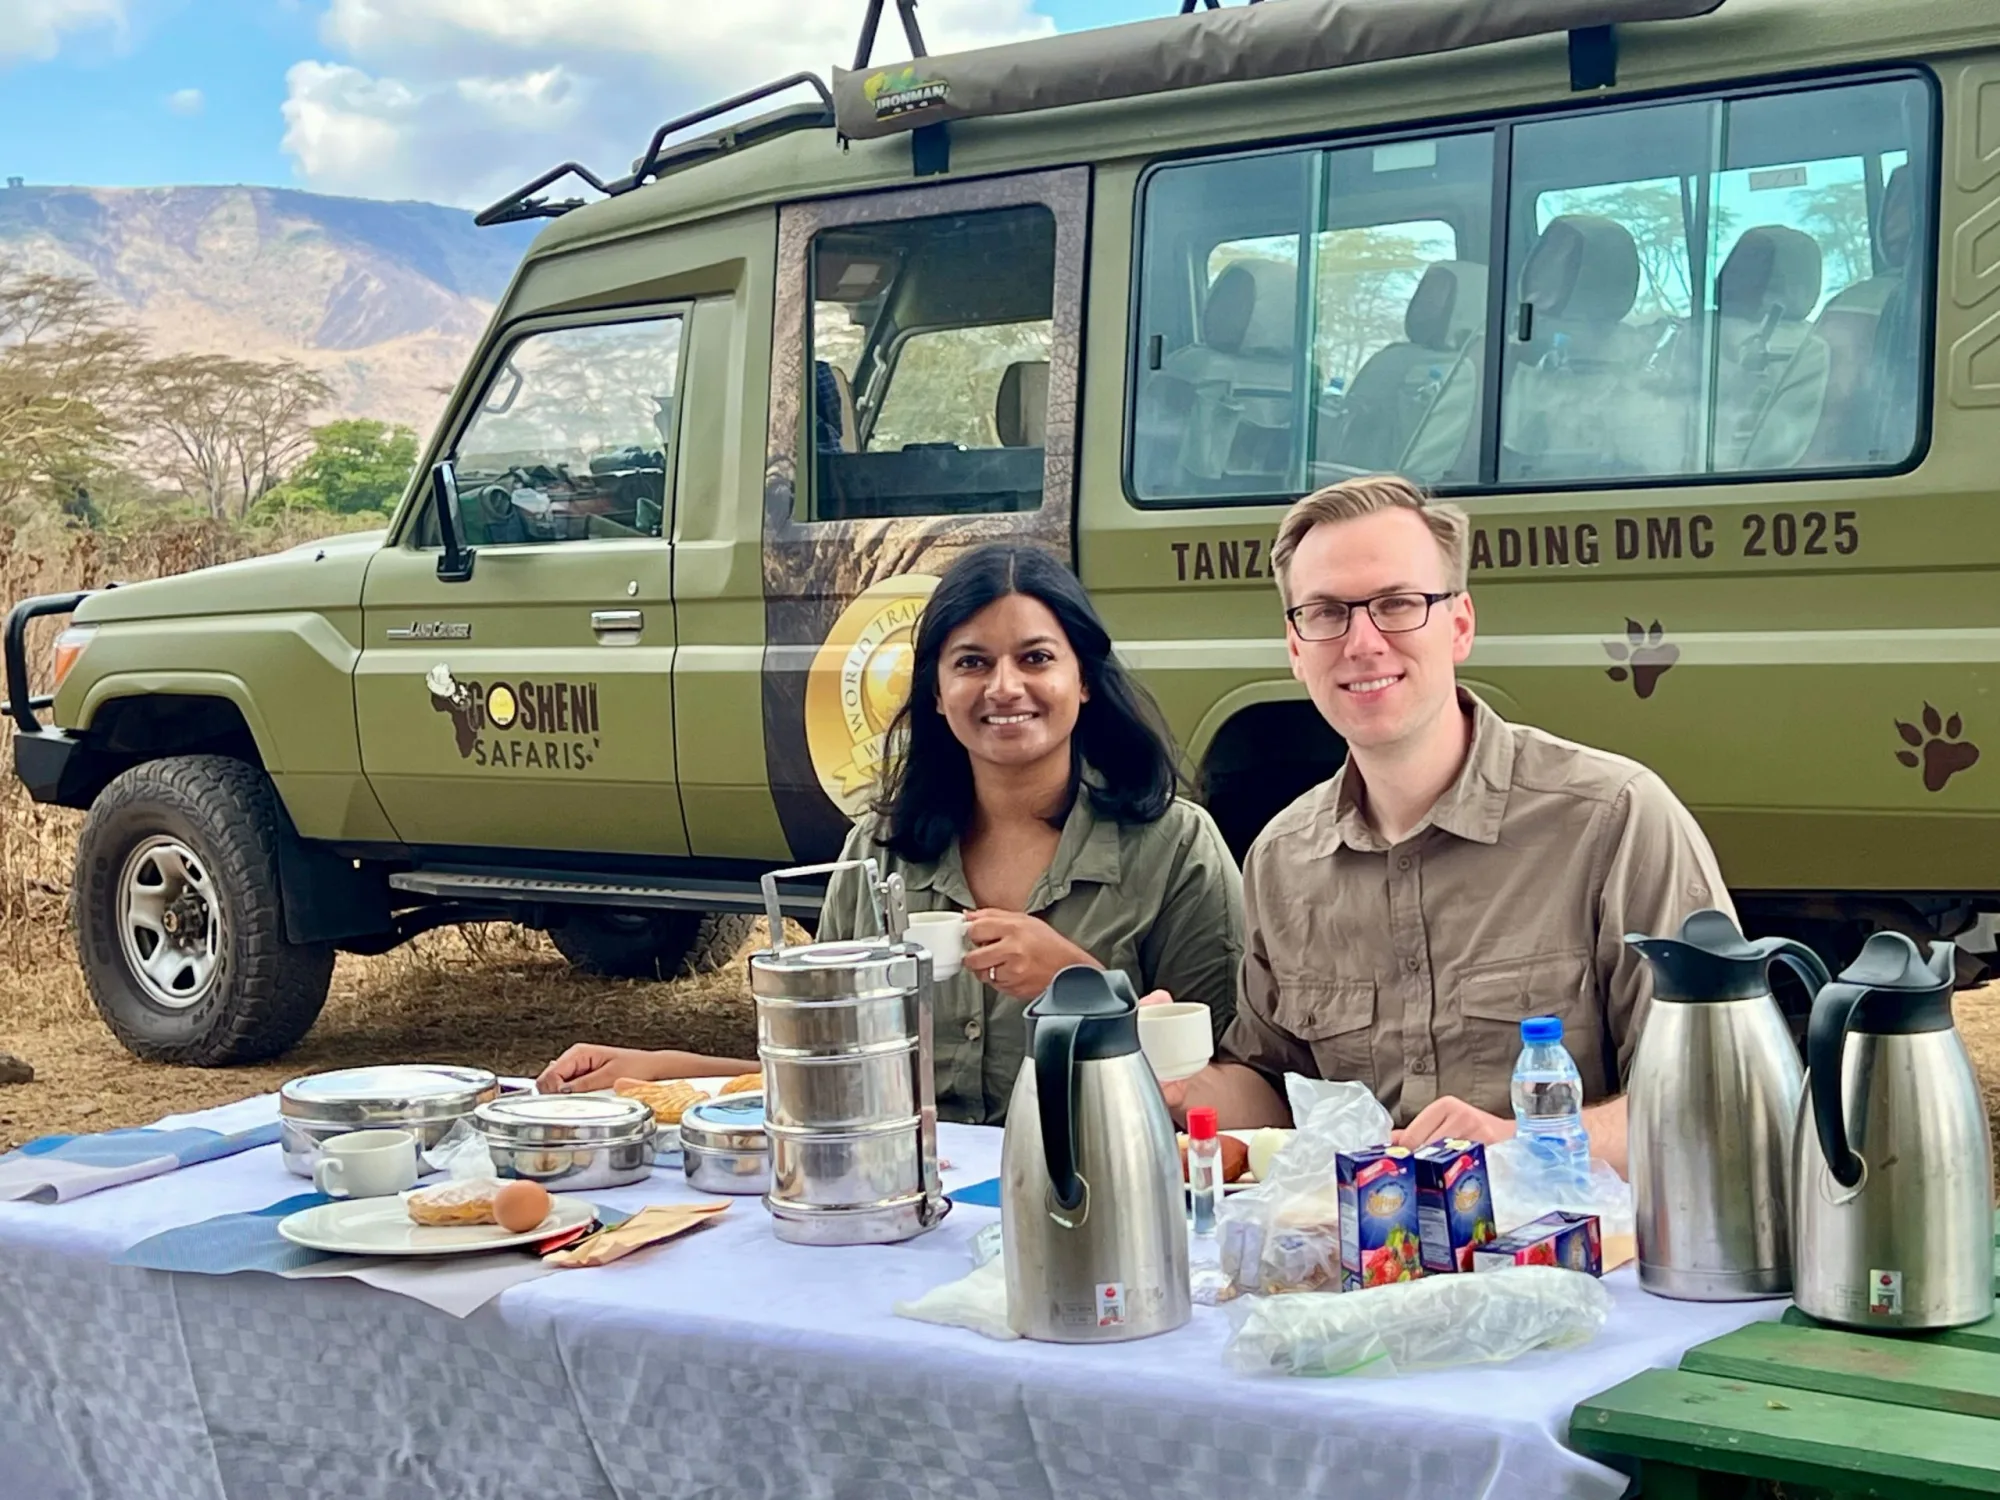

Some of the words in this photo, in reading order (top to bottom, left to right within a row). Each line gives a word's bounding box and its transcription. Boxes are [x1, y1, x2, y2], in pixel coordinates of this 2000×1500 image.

[875, 84, 946, 109] IRONMAN
[1469, 522, 1599, 570] ADING
[1615, 514, 1715, 561] DMC
[1742, 511, 1860, 557] 2025
[467, 680, 600, 734] GOSHENI
[845, 637, 873, 734] WORLD
[474, 739, 587, 770] SAFARIS
